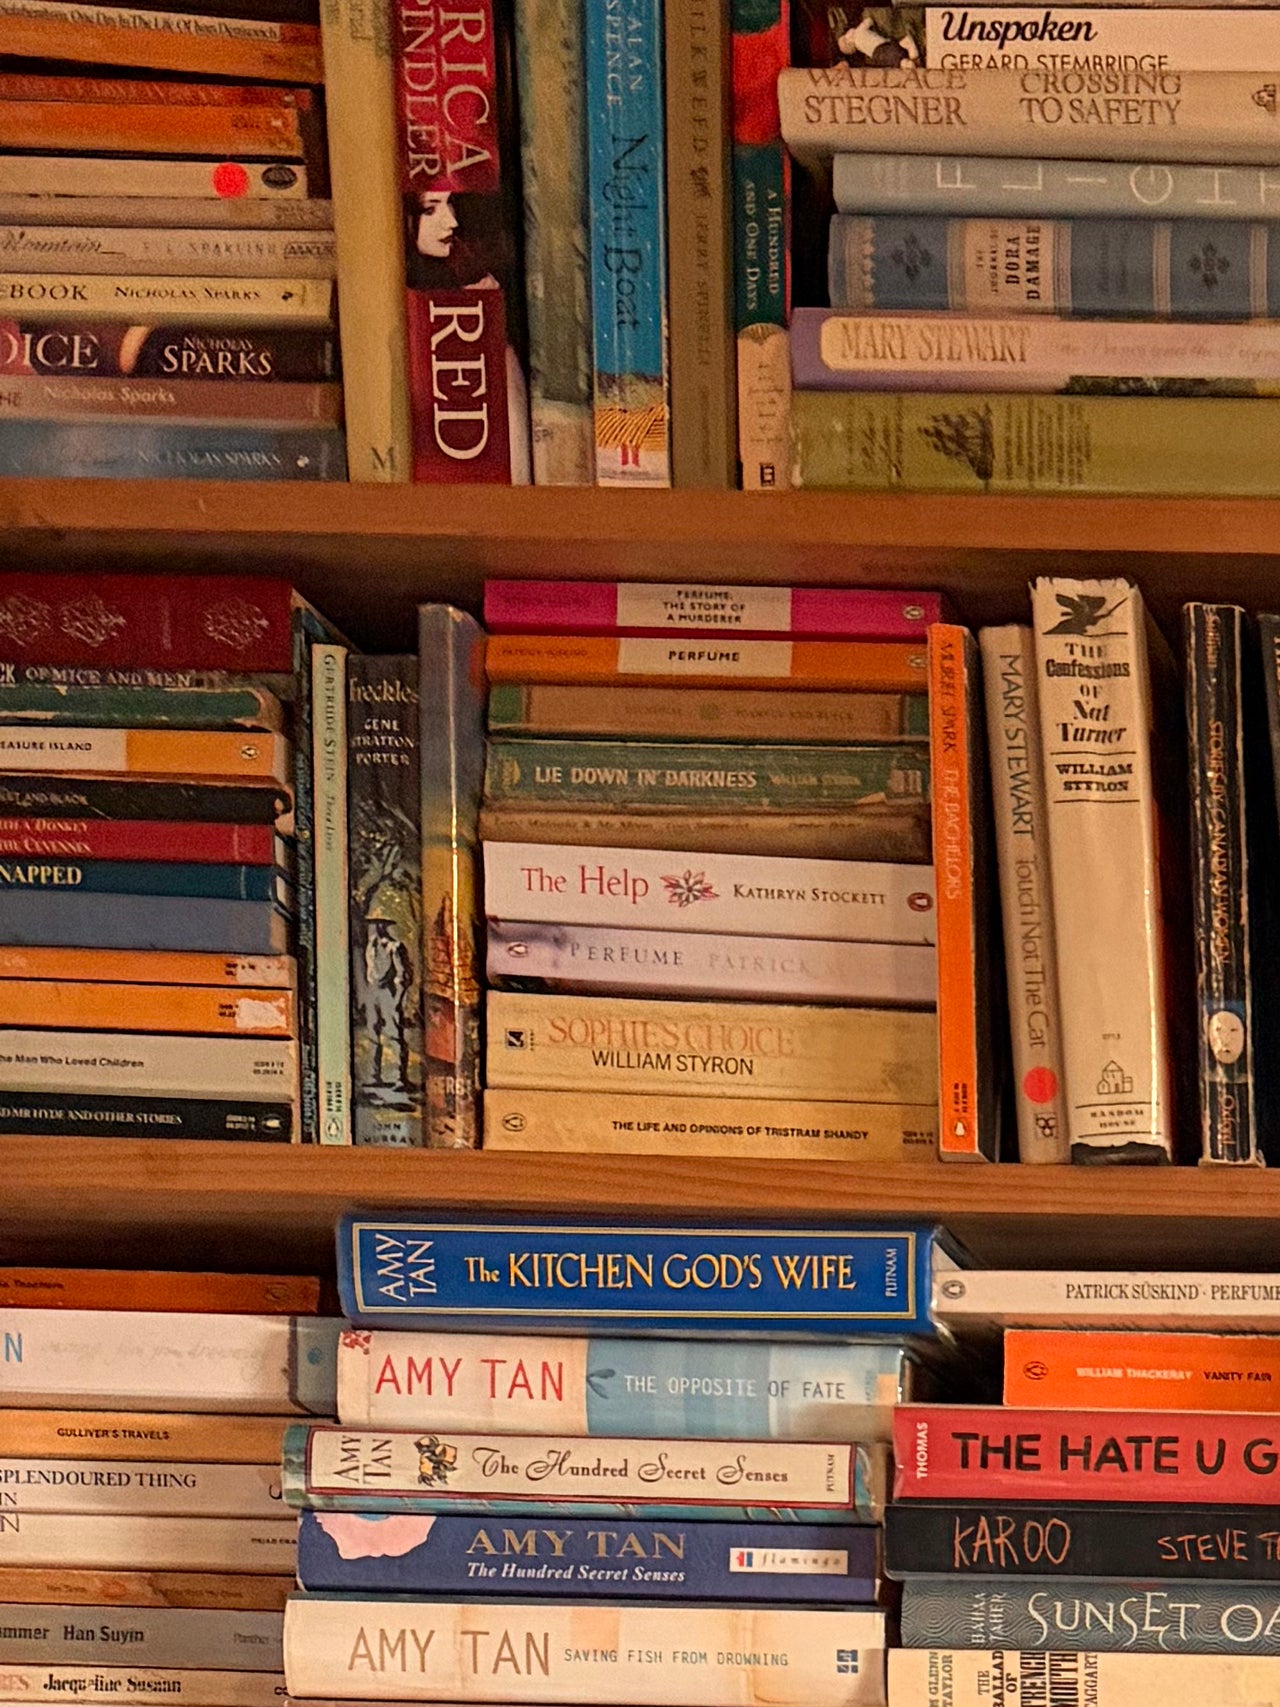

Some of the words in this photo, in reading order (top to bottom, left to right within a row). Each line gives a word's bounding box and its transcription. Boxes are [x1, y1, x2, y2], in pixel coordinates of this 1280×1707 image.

[941, 11, 1097, 46] Unspoken
[804, 95, 967, 127] STEGNER
[163, 345, 271, 375] SPARKS
[429, 299, 487, 460] RED
[521, 867, 567, 893] The
[579, 866, 648, 902] Help
[733, 882, 805, 903] KATHRYN
[811, 886, 886, 905] STOCKETT
[592, 1050, 669, 1071] WILLIAM
[676, 1054, 754, 1075] STYRON
[464, 1256, 499, 1283] The
[508, 1253, 657, 1289] KITCHEN
[664, 1255, 761, 1289] GOD'S
[771, 1256, 856, 1290] WIFE
[375, 1358, 463, 1395] AMY
[481, 1358, 565, 1400] TAN
[952, 1433, 1040, 1470] THE
[1059, 1435, 1178, 1473] HATE
[1197, 1439, 1226, 1474] U
[953, 1516, 1071, 1567] KAROO
[1026, 1591, 1201, 1650] SUNSET
[564, 1648, 617, 1662] SAVING
[627, 1649, 662, 1663] FISH
[673, 1650, 707, 1665] FROM
[716, 1651, 788, 1666] DROWNING
